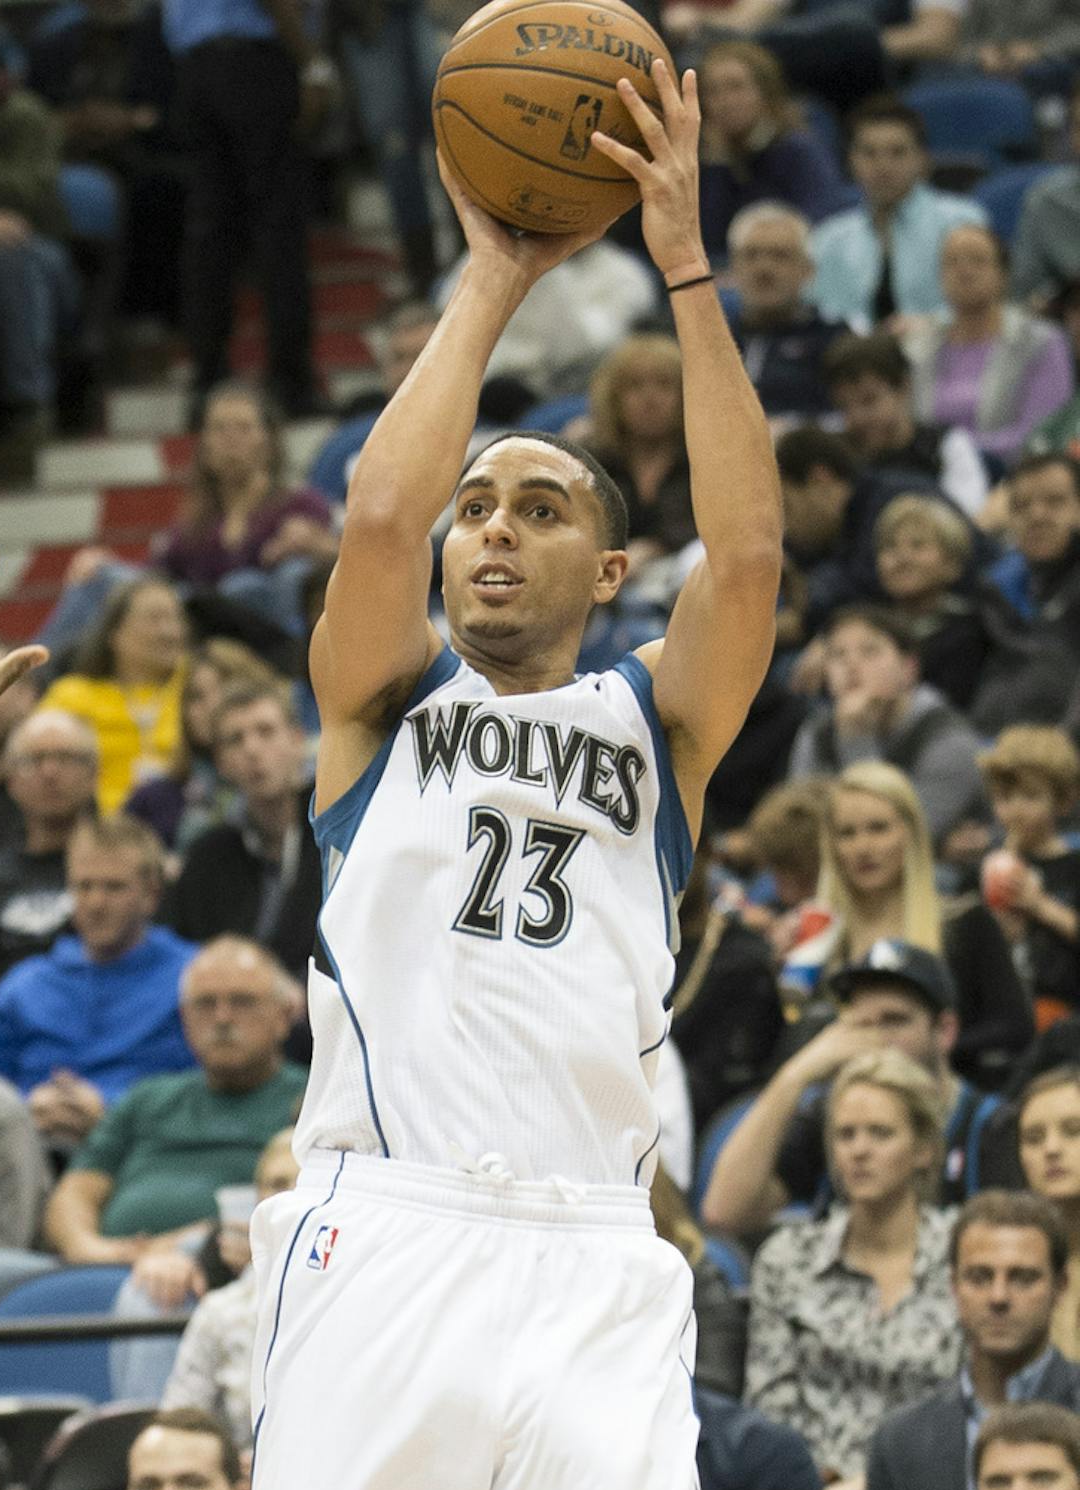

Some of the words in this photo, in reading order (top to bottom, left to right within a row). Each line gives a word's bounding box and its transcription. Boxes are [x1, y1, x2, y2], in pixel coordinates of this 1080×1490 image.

[515, 22, 654, 78] SPALDIN
[403, 701, 647, 836] WOLVES
[451, 805, 588, 949] 23
